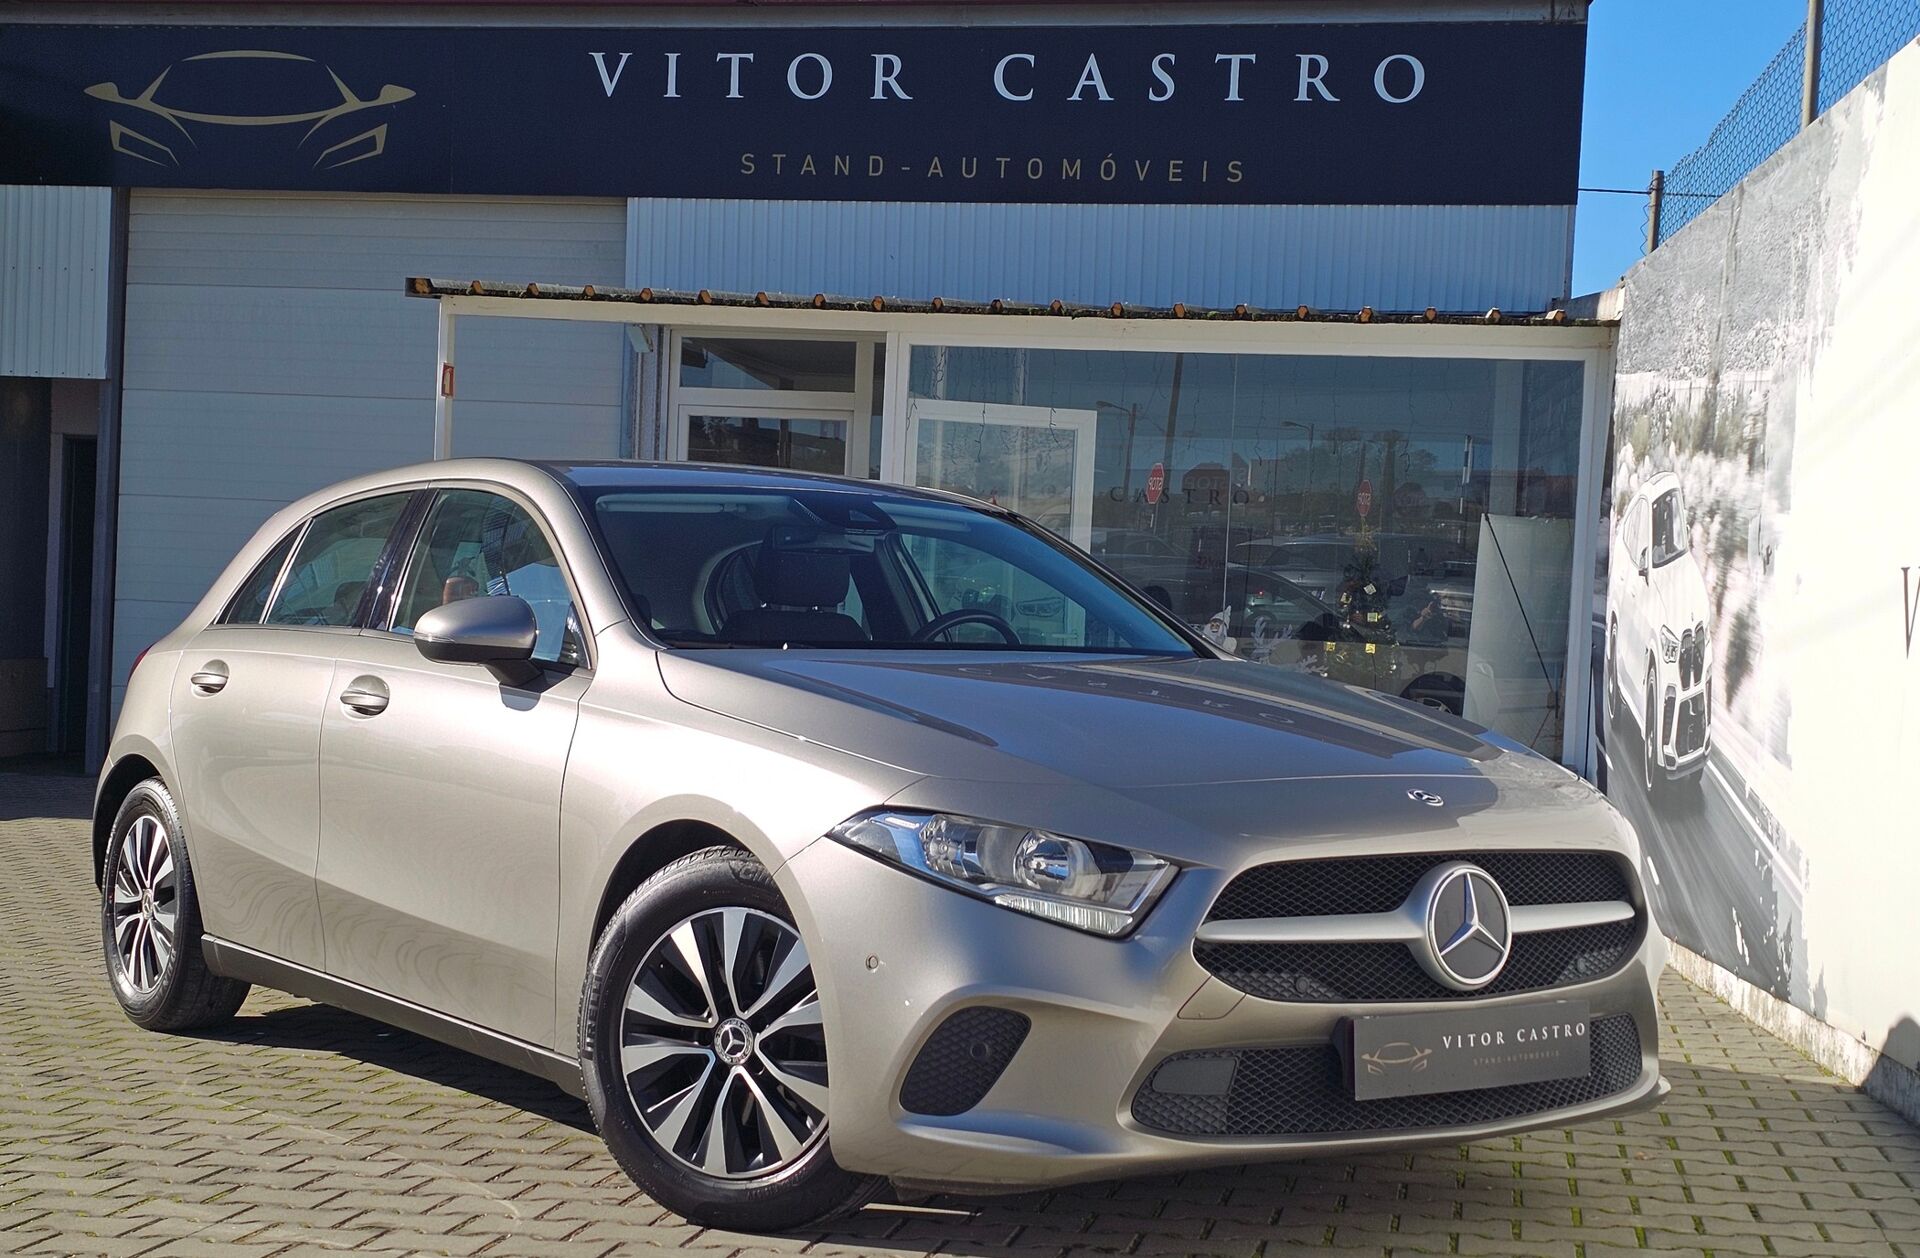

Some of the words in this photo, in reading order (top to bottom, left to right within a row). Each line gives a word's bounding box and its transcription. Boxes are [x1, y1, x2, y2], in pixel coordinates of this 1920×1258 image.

[588, 52, 913, 100] VITOR
[993, 53, 1426, 103] CASTRO
[740, 153, 1244, 183] STAND-AUTOMÓVEIS
[1442, 1032, 1505, 1049] VITOR
[1516, 1022, 1586, 1043] CASTRO
